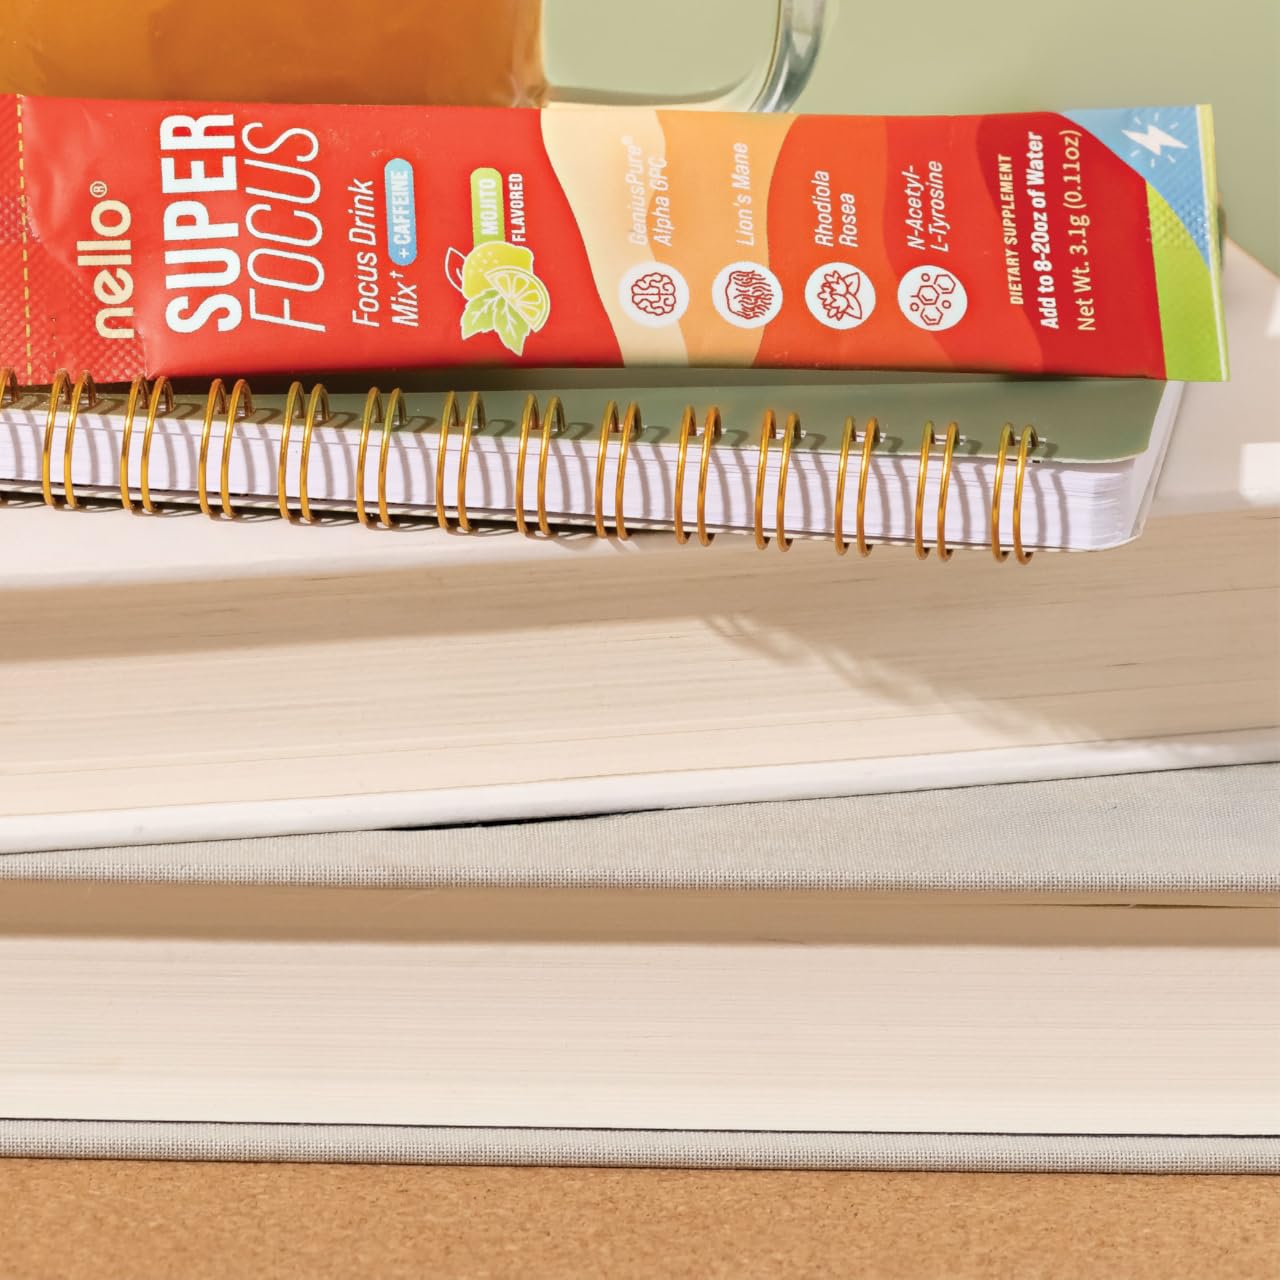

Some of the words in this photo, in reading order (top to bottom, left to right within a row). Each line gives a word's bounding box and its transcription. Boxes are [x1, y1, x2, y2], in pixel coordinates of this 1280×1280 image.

[648, 156, 669, 191] GPC
[731, 143, 751, 190] Mane
[1025, 131, 1045, 185] Water
[1059, 129, 1087, 209] (0.11oz)
[160, 113, 243, 333] SUPER
[347, 178, 377, 246] Drink
[391, 170, 412, 246] CAFFEINE
[479, 178, 497, 235] MOJITO
[509, 173, 526, 242] FLAVORED
[652, 196, 675, 247] Alpha
[733, 194, 755, 246] Lion's
[812, 170, 834, 247] Rhodiola
[839, 193, 858, 248] Rosea
[902, 165, 925, 251] N-Acetyl-
[923, 161, 949, 252] L-Tyrosine
[998, 153, 1019, 245] SUPPLEMENT
[1027, 188, 1046, 208] of
[242, 122, 326, 333] FOCUS
[1030, 212, 1053, 272] 8-20oz
[1067, 214, 1090, 256] 3.1g
[352, 251, 380, 328] Focus
[1005, 248, 1024, 305] DIETARY
[1037, 275, 1054, 293] to
[1071, 262, 1092, 293] Wt.
[1037, 297, 1060, 329] Add
[1075, 298, 1096, 331] Net
